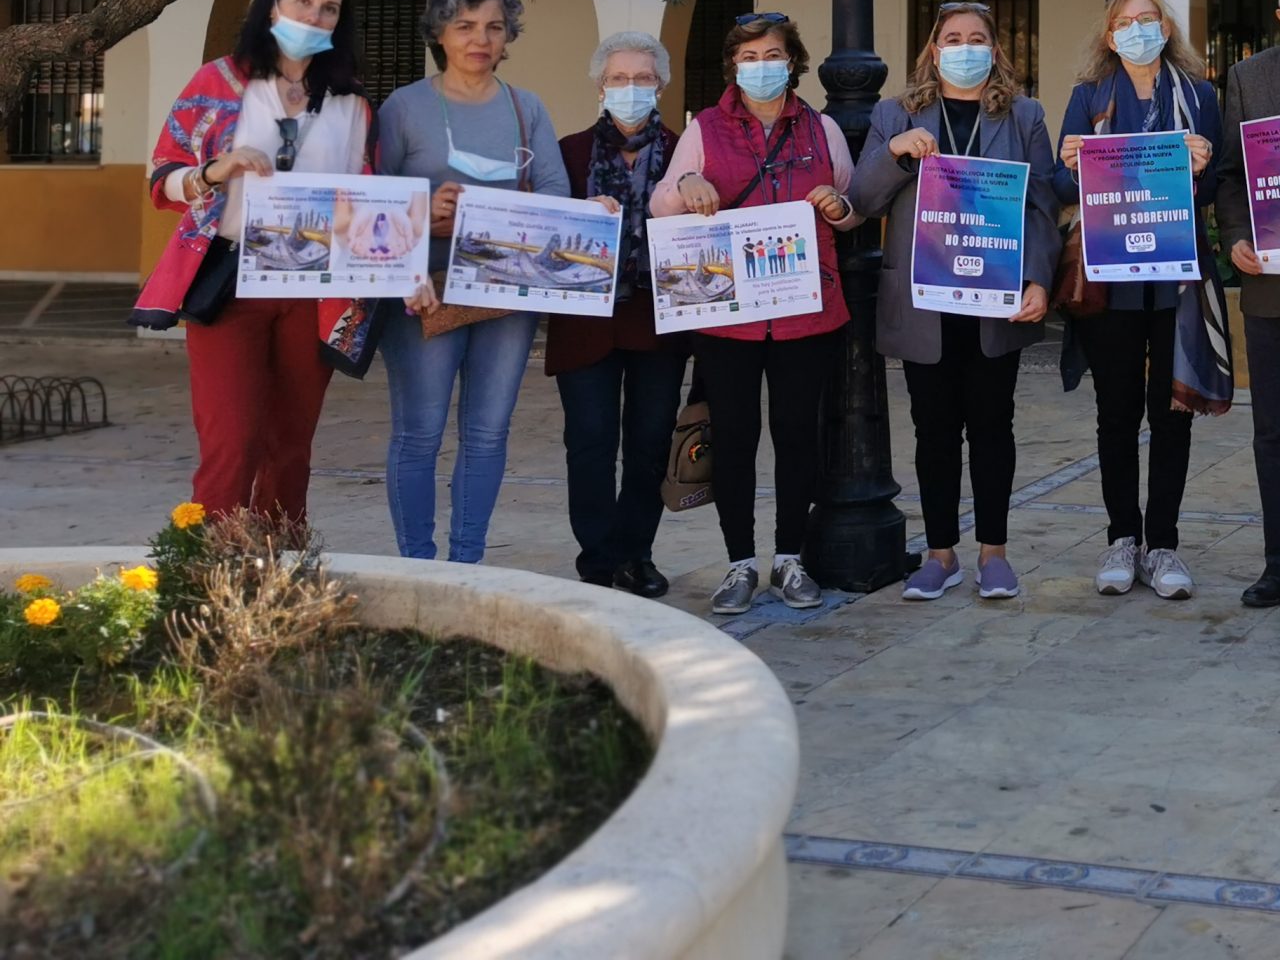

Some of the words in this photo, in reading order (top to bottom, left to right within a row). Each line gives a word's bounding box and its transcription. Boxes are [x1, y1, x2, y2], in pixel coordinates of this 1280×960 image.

[1256, 177, 1266, 188] NI
[1086, 192, 1121, 206] QUIERO
[1255, 190, 1265, 201] NI
[922, 210, 956, 224] QUIERO
[1113, 213, 1127, 226] NO
[1130, 208, 1189, 224] SOBREVIVIR
[944, 234, 959, 246] NO
[962, 234, 1018, 250] SOBREVIVIR
[1134, 234, 1152, 244] 016
[962, 258, 980, 267] 016
